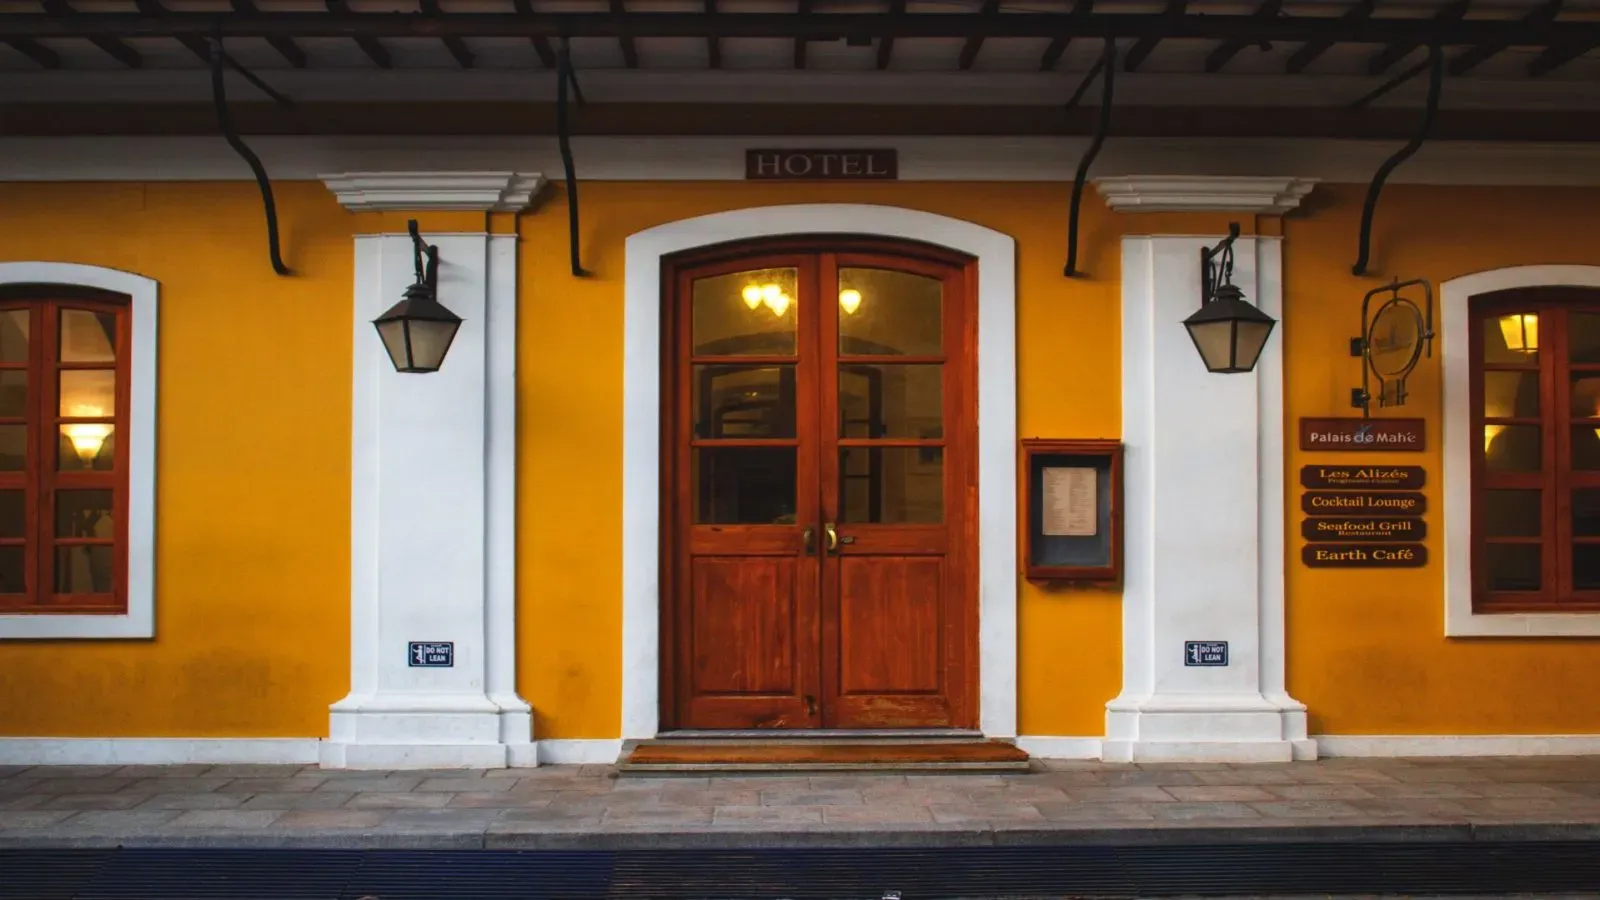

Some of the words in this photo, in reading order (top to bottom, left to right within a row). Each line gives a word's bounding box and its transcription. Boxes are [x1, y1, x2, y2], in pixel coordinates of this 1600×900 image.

[757, 154, 888, 175] HOTEL
[1310, 432, 1351, 443] Palais
[1353, 431, 1374, 443] de
[1376, 431, 1416, 443] Mahé
[1319, 469, 1350, 478] Les
[1355, 468, 1409, 478] Alizés
[1311, 496, 1364, 507] Cocktail
[1368, 496, 1416, 509] Lounge
[1317, 521, 1375, 531] Seafood
[1379, 521, 1412, 531] Grill
[1316, 550, 1367, 560] Earth
[1373, 549, 1415, 560] Café
